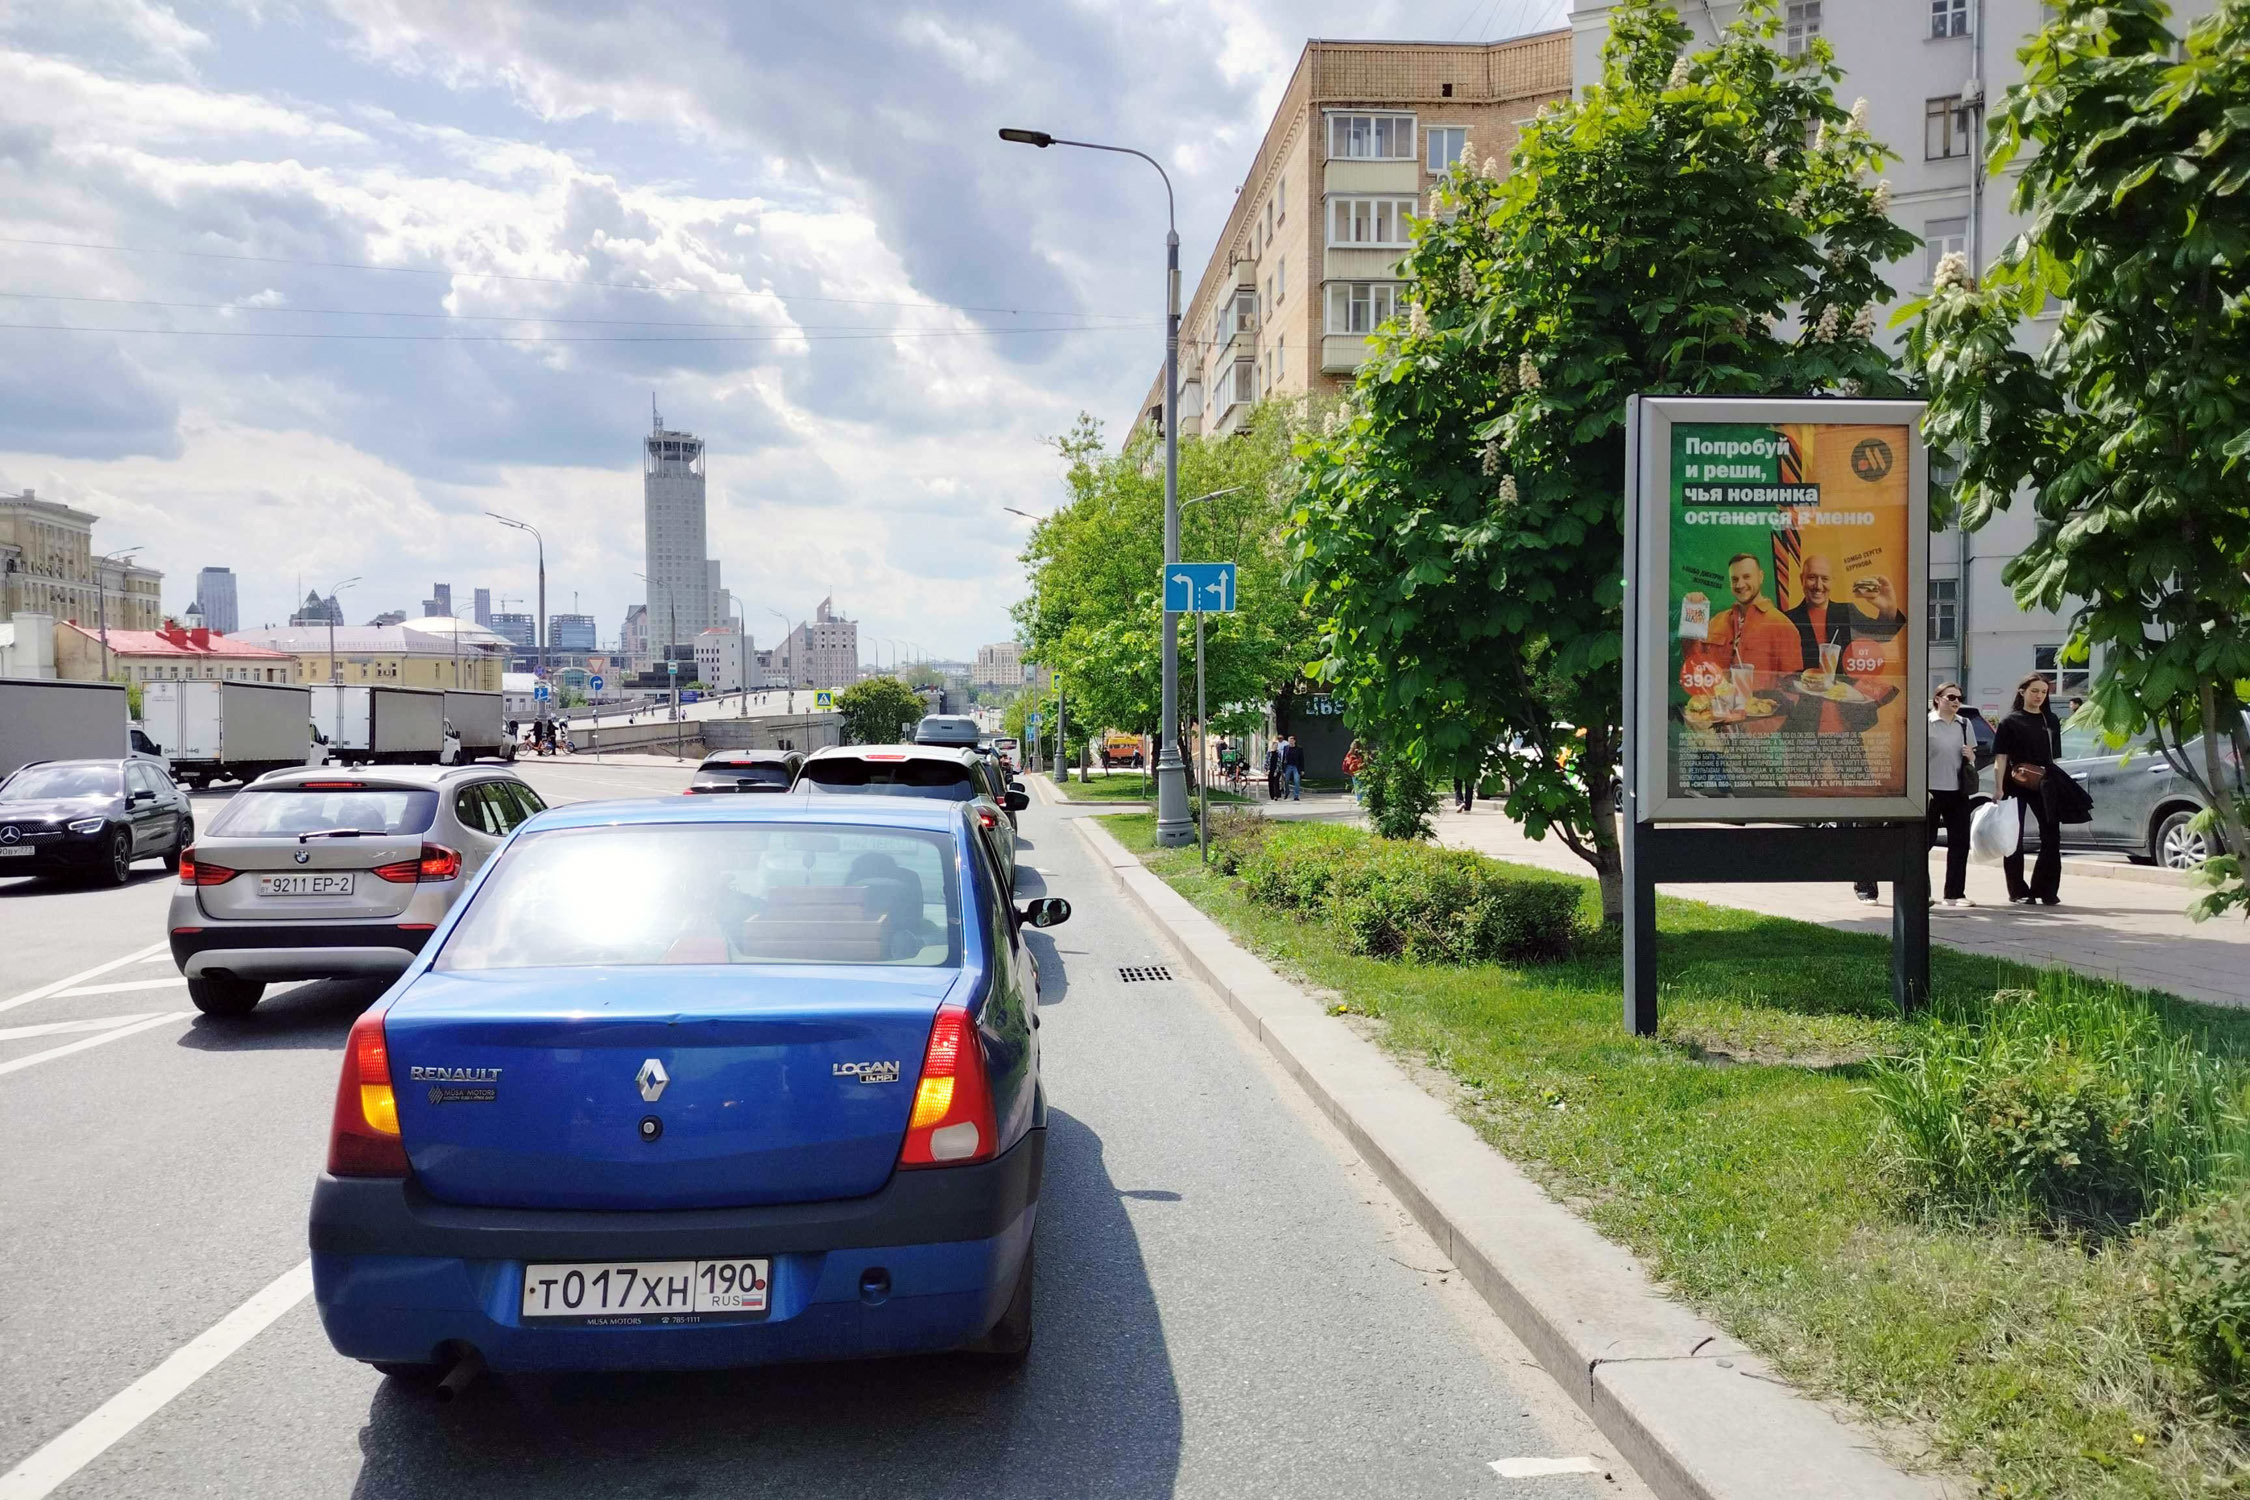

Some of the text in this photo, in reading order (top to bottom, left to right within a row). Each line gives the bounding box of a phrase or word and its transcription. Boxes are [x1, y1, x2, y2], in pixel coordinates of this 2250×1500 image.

[1684, 436, 1791, 459] Попробуй
[1684, 463, 1767, 482] и реши,
[1684, 487, 1819, 502] чья новинка
[1684, 510, 1792, 526] останется
[1815, 511, 1875, 525] меню
[273, 877, 349, 893] 9211 EP-2
[410, 1066, 503, 1082] RENAULT
[832, 1060, 900, 1076] LOGAN
[700, 1262, 757, 1295] 190
[711, 1295, 742, 1307] RUS
[586, 1316, 701, 1326] MUSA MOTORS 785-1111
